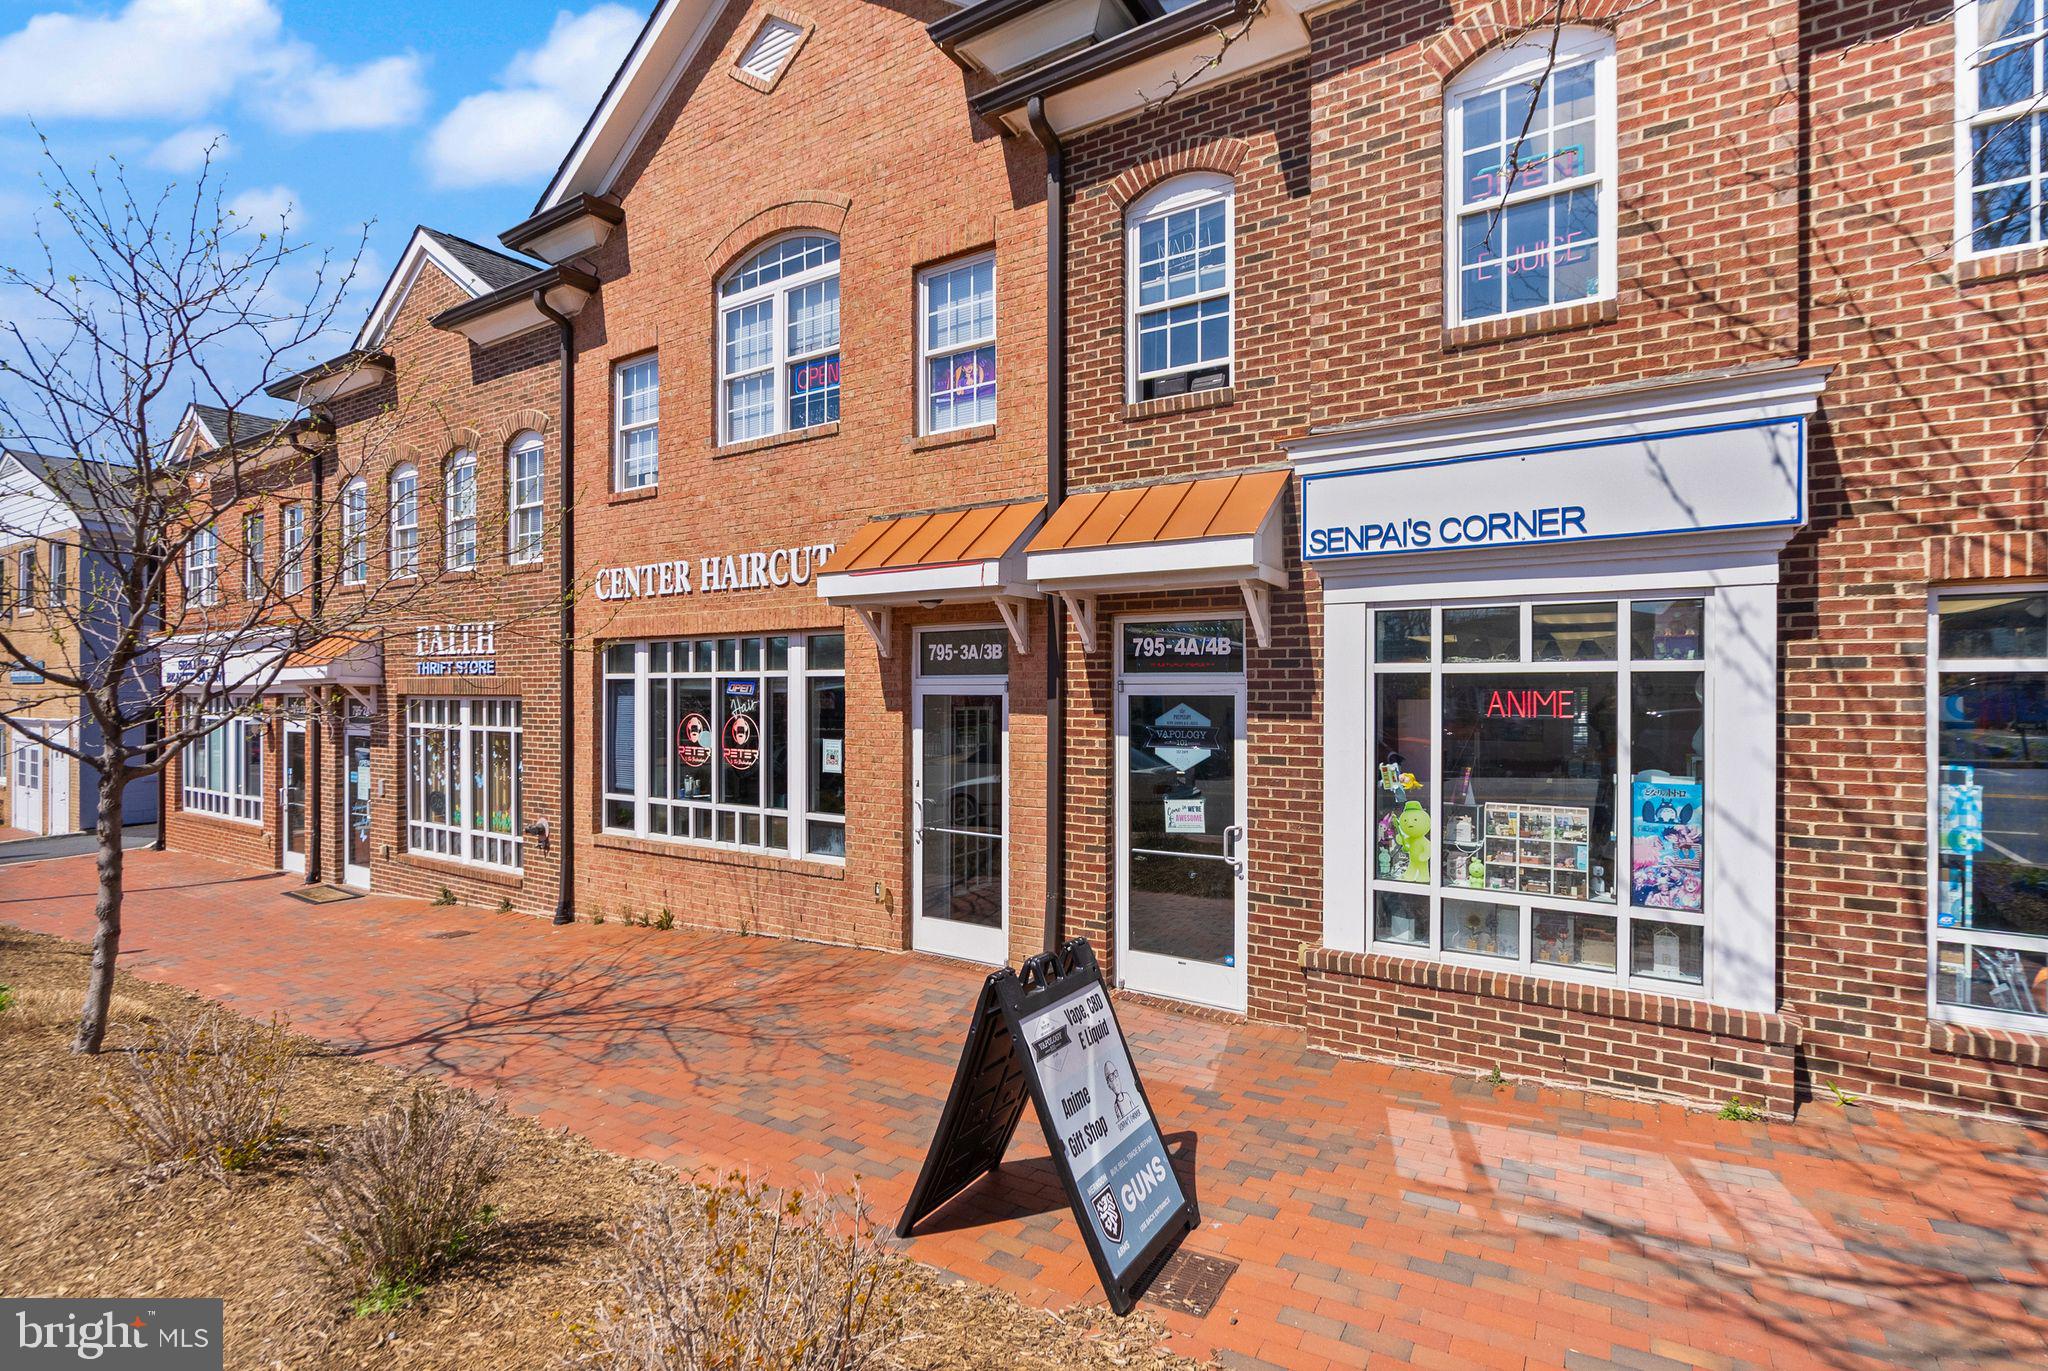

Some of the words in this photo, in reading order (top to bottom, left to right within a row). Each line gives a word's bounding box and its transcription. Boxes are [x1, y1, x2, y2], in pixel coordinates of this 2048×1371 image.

[797, 361, 840, 390] OPEN
[1309, 518, 1431, 554] SENPAI'S
[1439, 506, 1588, 543] CORNER
[594, 560, 693, 601] CENTER
[416, 622, 496, 656] FAITH
[928, 643, 1003, 661] 795-3A/3B
[1132, 636, 1232, 657] 795-4A/4B
[416, 662, 453, 675] THRIFT
[455, 660, 496, 675] STORE
[730, 684, 752, 693] OPEN
[1486, 690, 1574, 718] ANIME
[1156, 730, 1207, 739] VAPOLOGY
[678, 746, 711, 756] PETER
[723, 748, 760, 759] PETER
[1175, 814, 1202, 822] AWESOME
[1063, 1003, 1090, 1026] Vape,
[1086, 993, 1104, 1014] CBD
[1078, 1031, 1087, 1050] E
[1084, 1018, 1110, 1047] Liquid
[1061, 1086, 1091, 1119] Anime
[1067, 1129, 1088, 1158] Gift
[1083, 1115, 1109, 1146] Shop
[1121, 1155, 1166, 1213] GUNS
